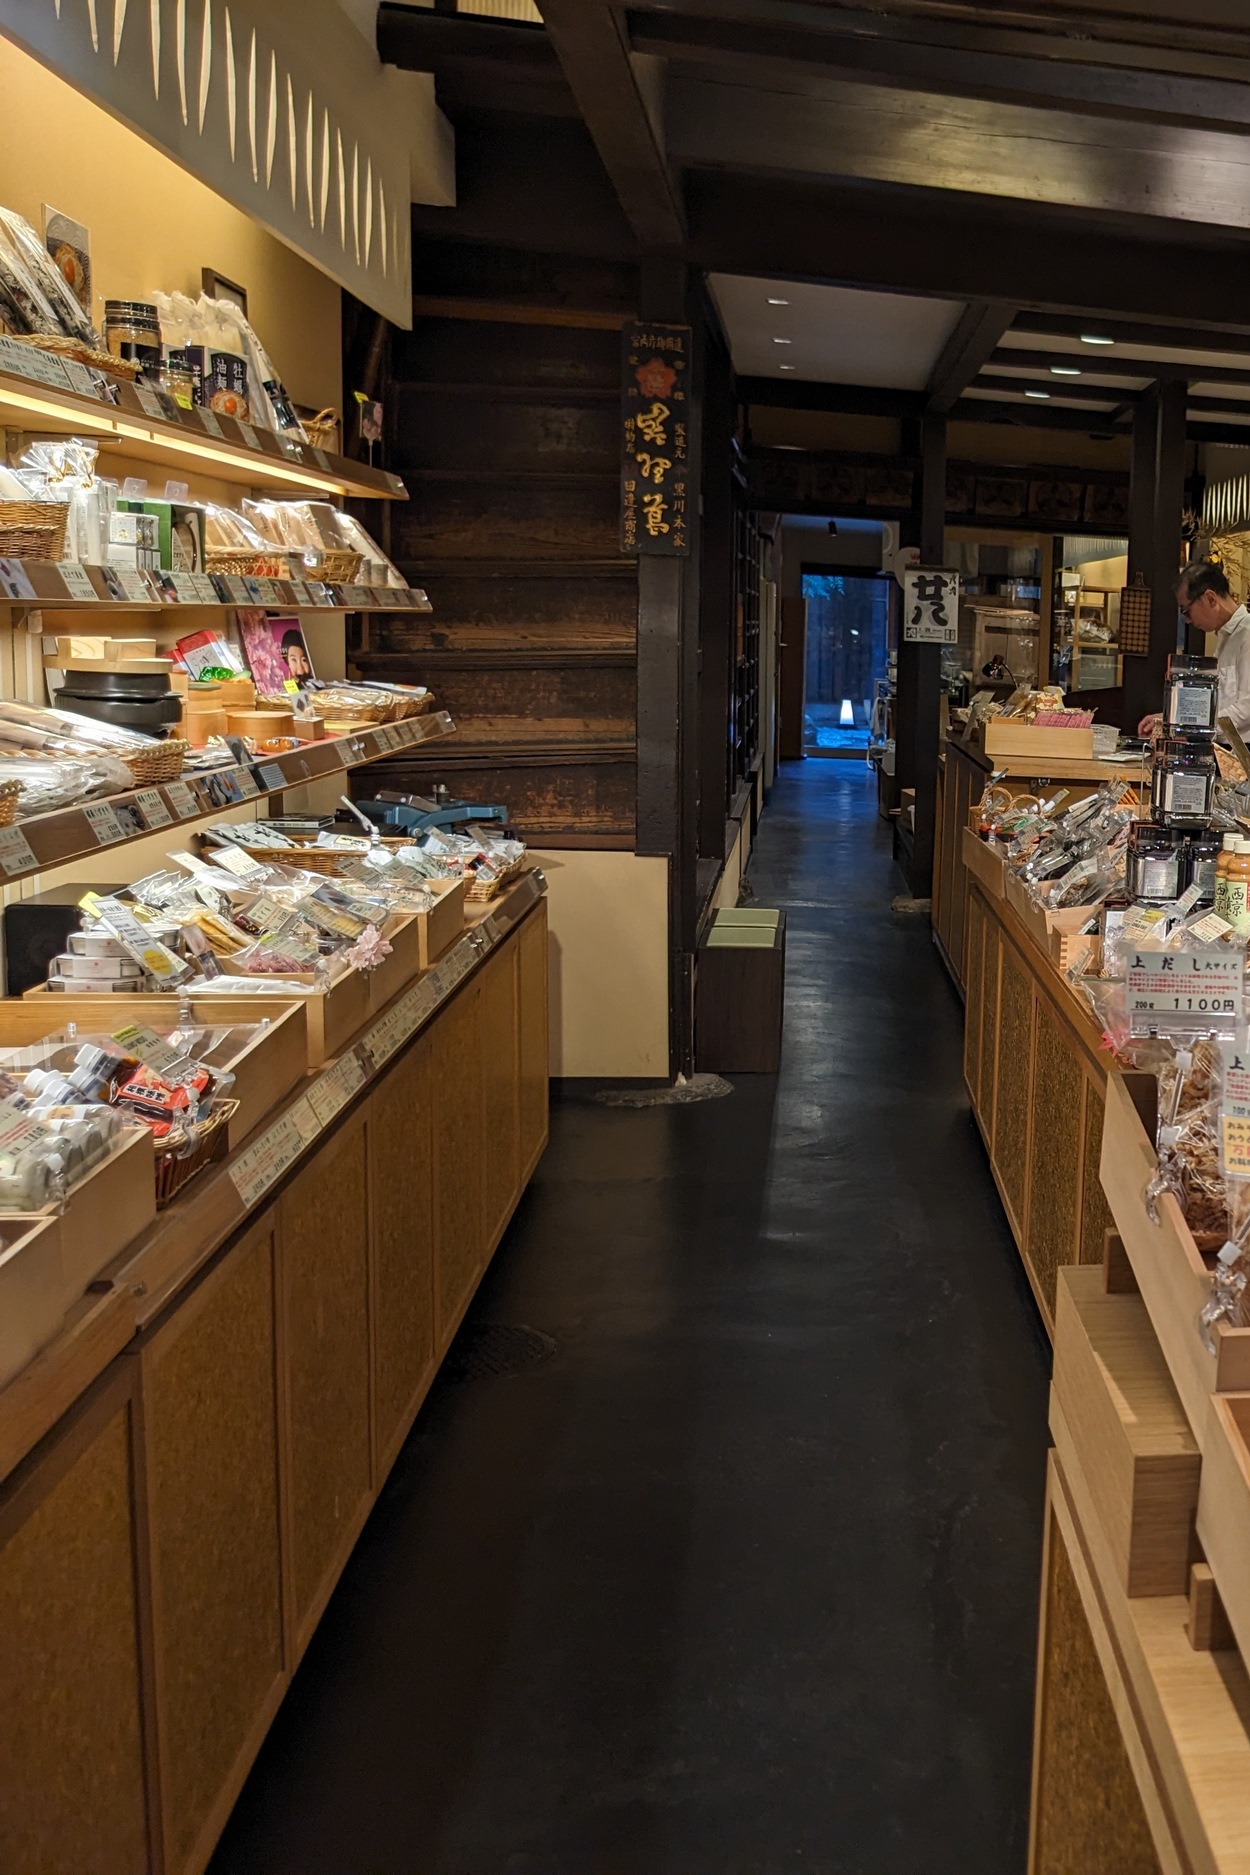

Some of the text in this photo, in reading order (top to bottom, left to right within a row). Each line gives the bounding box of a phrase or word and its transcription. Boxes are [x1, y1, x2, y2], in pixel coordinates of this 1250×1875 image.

[1231, 887, 1245, 917] 西京
[1130, 954, 1238, 972] 上だし 大サイズ
[1173, 998, 1235, 1011] 1100円
